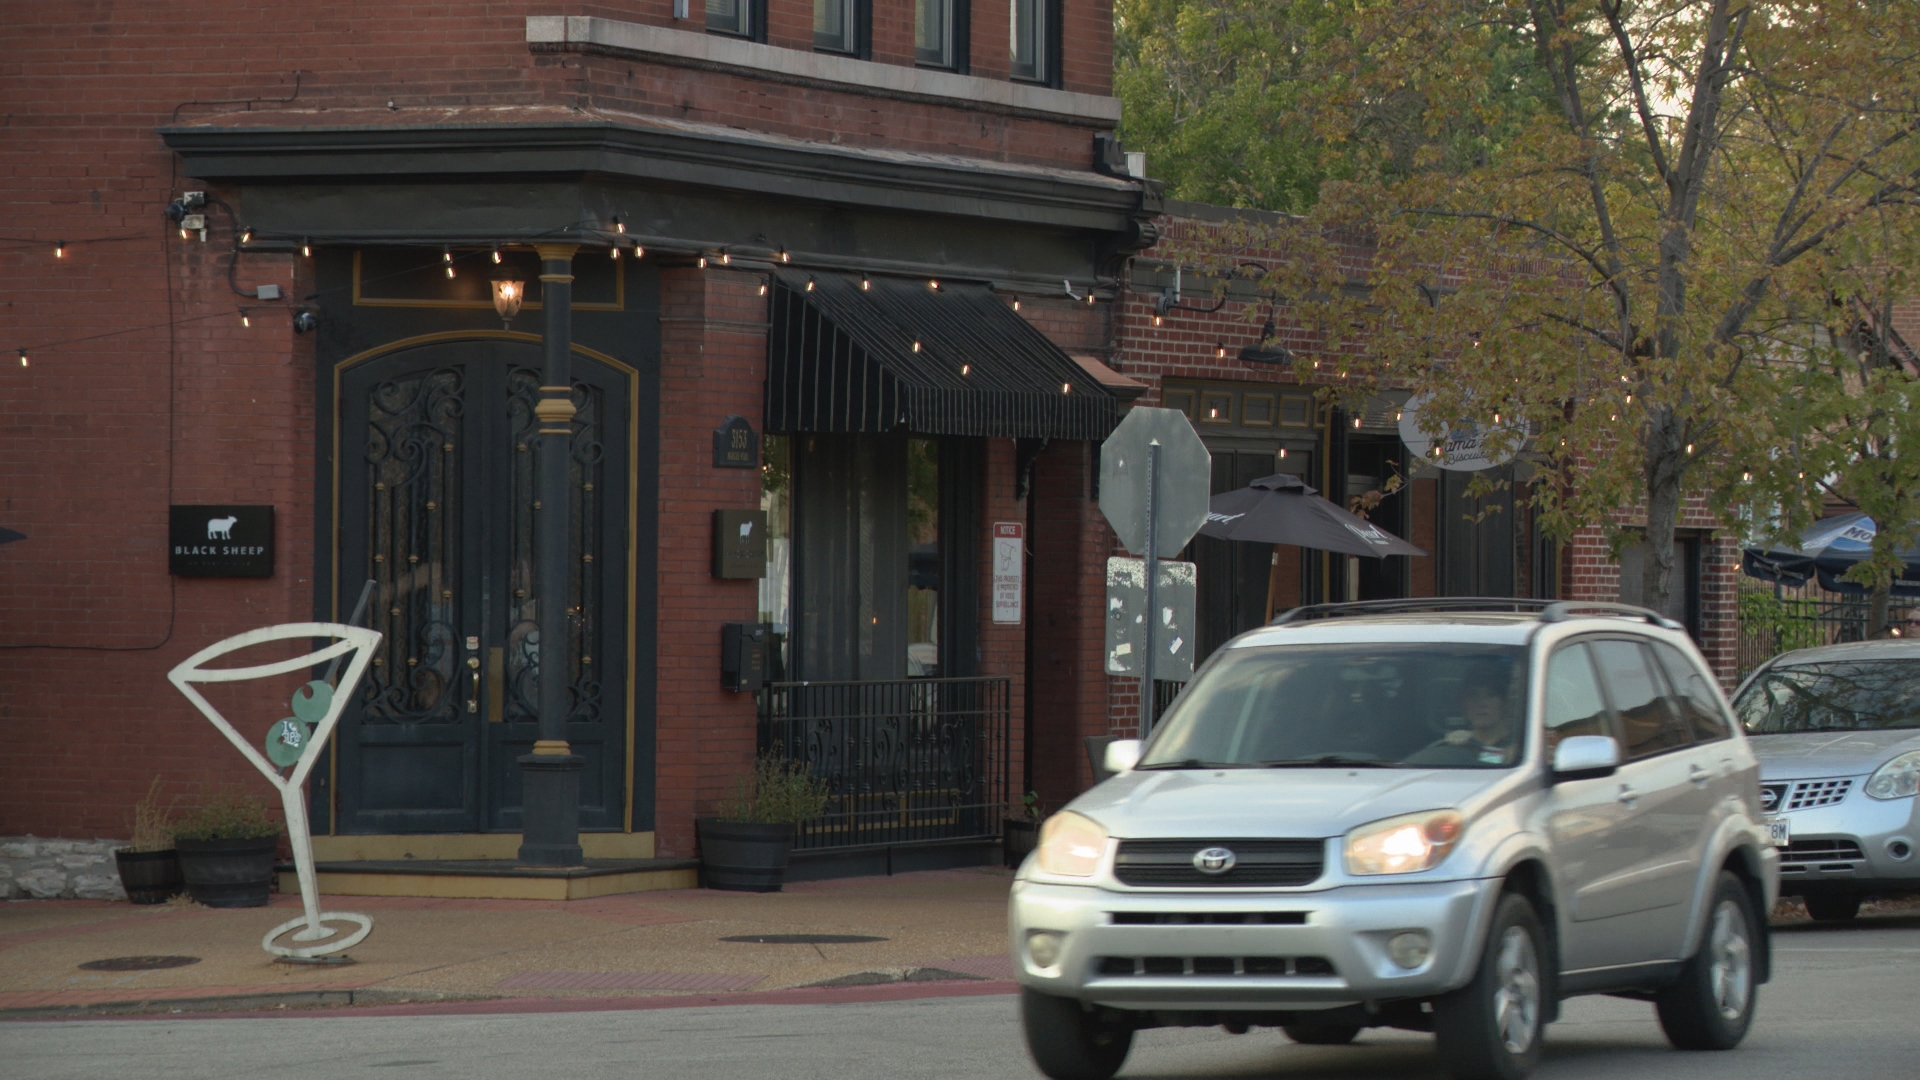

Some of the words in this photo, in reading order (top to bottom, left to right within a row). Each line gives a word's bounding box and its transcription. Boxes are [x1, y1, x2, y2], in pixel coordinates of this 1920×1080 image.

[1000, 526, 1016, 535] NOTICE
[175, 546, 217, 555] BLACK
[222, 546, 264, 555] SHEEP
